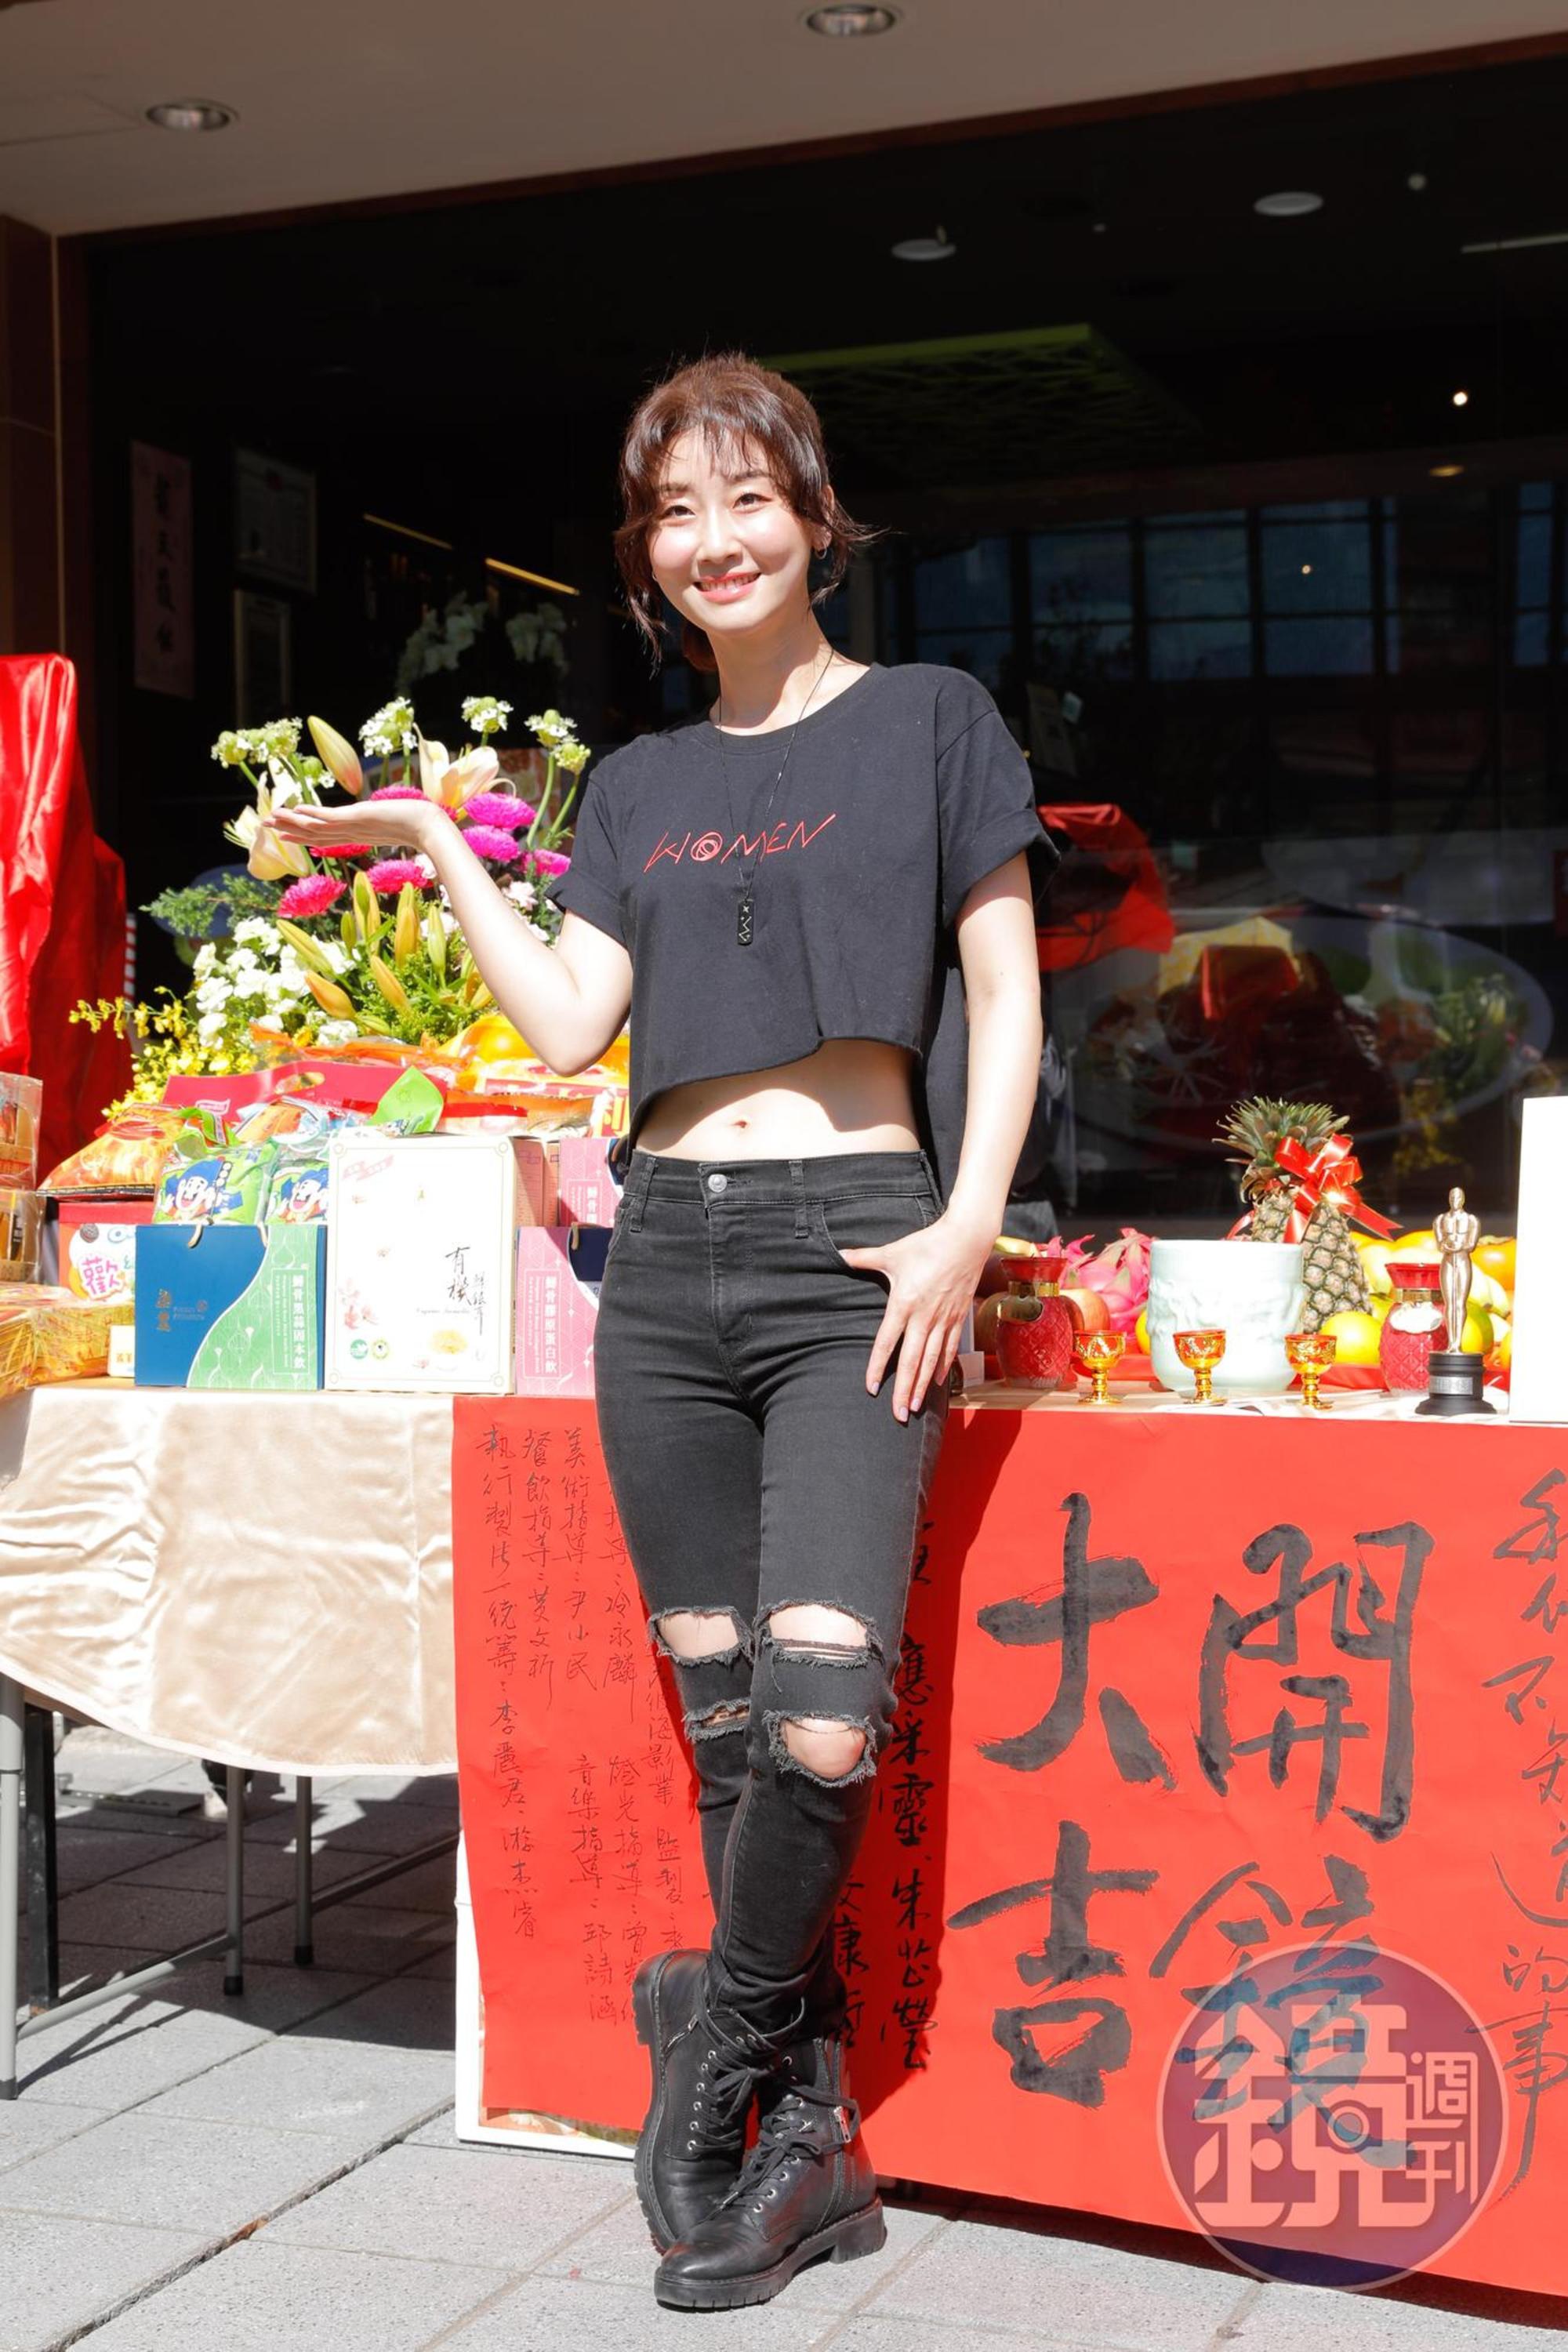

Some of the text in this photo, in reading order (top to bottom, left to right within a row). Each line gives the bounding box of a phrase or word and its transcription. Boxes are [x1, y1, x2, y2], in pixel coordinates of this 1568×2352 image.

[643, 813, 837, 873] WOMEN
[445, 1247, 472, 1306] 有機
[948, 1492, 1177, 2111] 大吉
